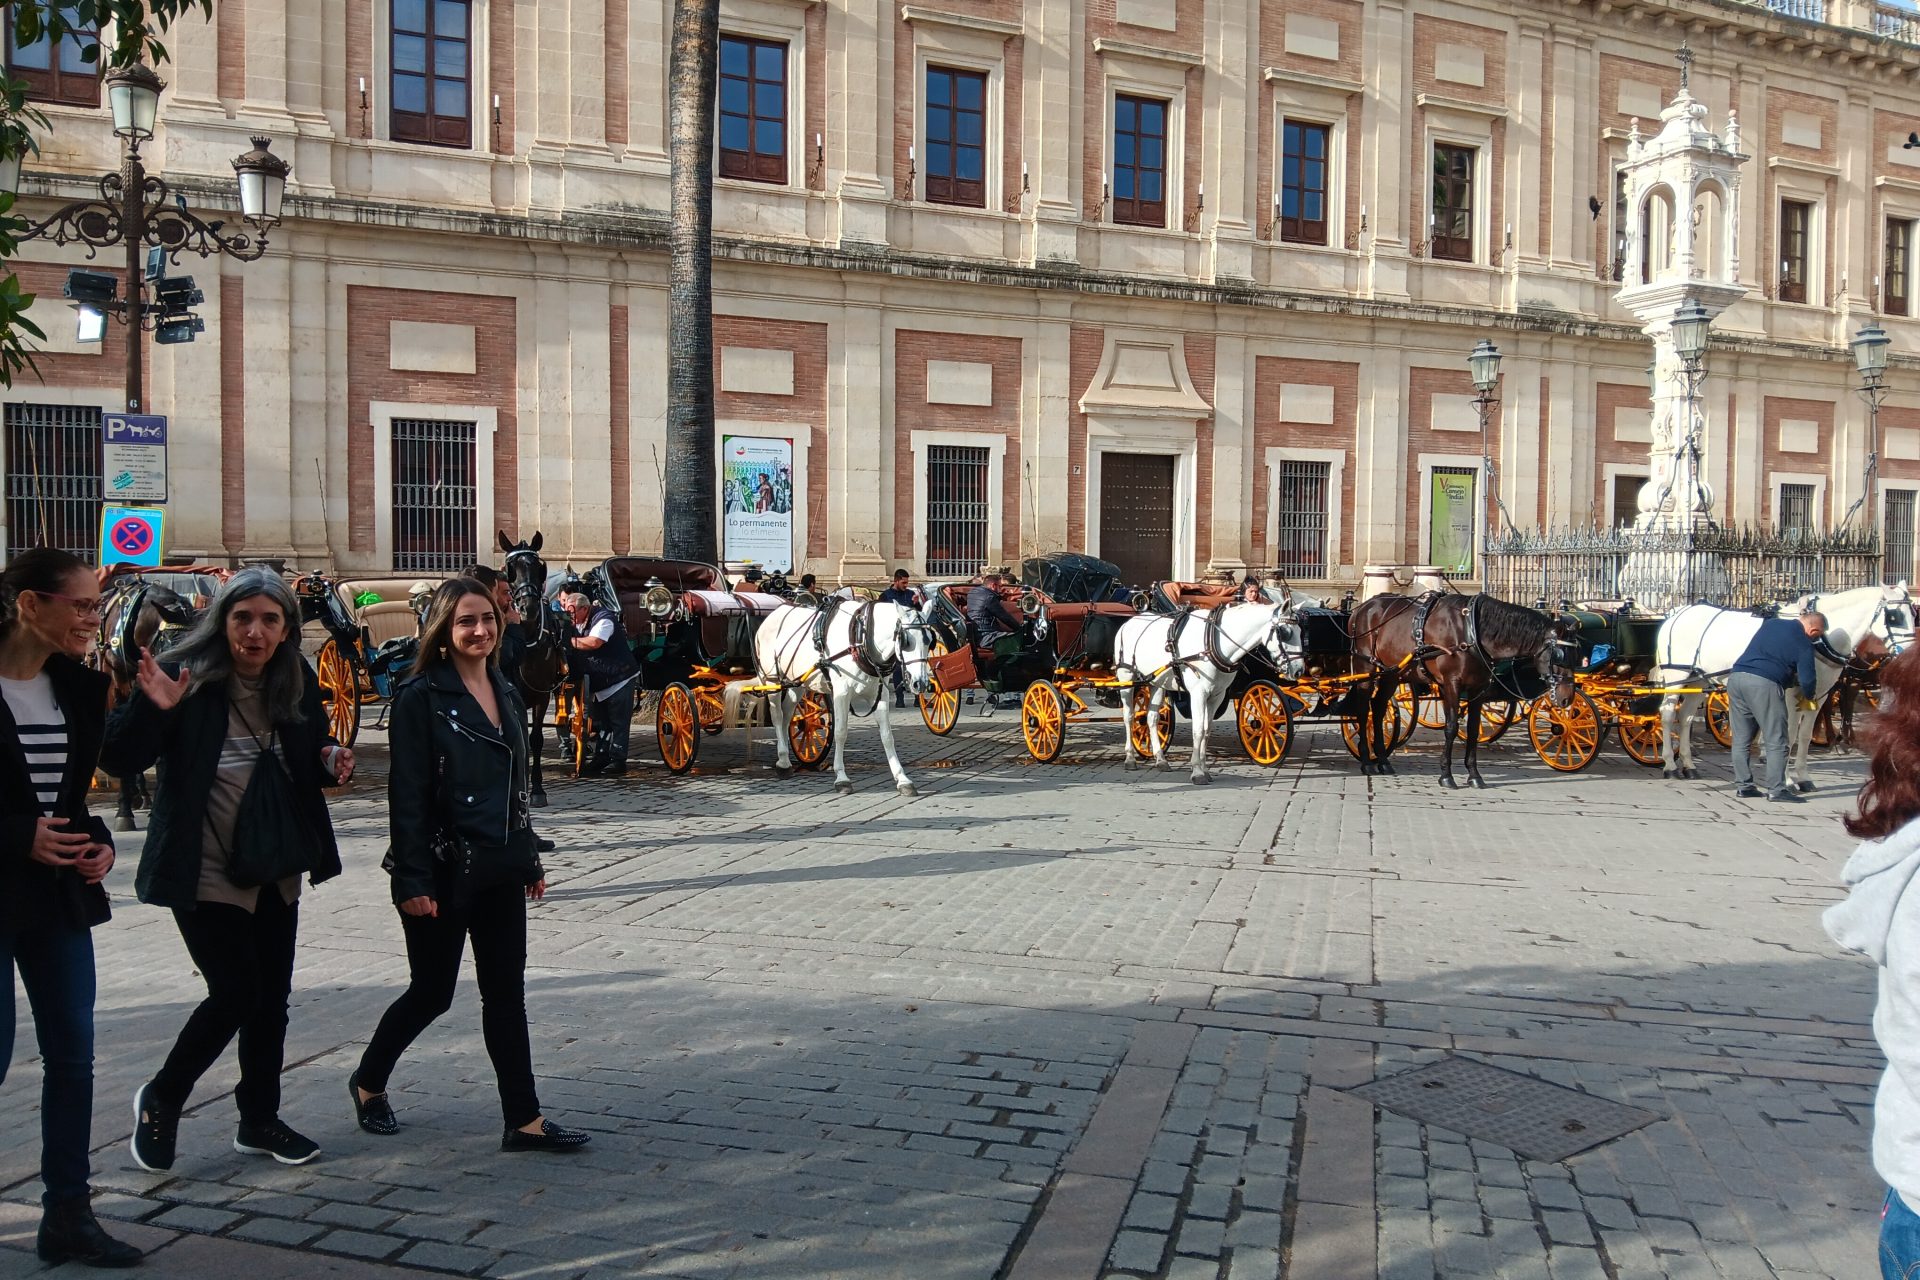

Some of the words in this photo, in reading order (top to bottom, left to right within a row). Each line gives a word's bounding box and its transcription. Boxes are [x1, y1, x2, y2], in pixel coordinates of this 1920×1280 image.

[130, 400, 138, 409] 6
[108, 418, 126, 439] P
[1440, 478, 1448, 490] V
[742, 527, 749, 536] lo
